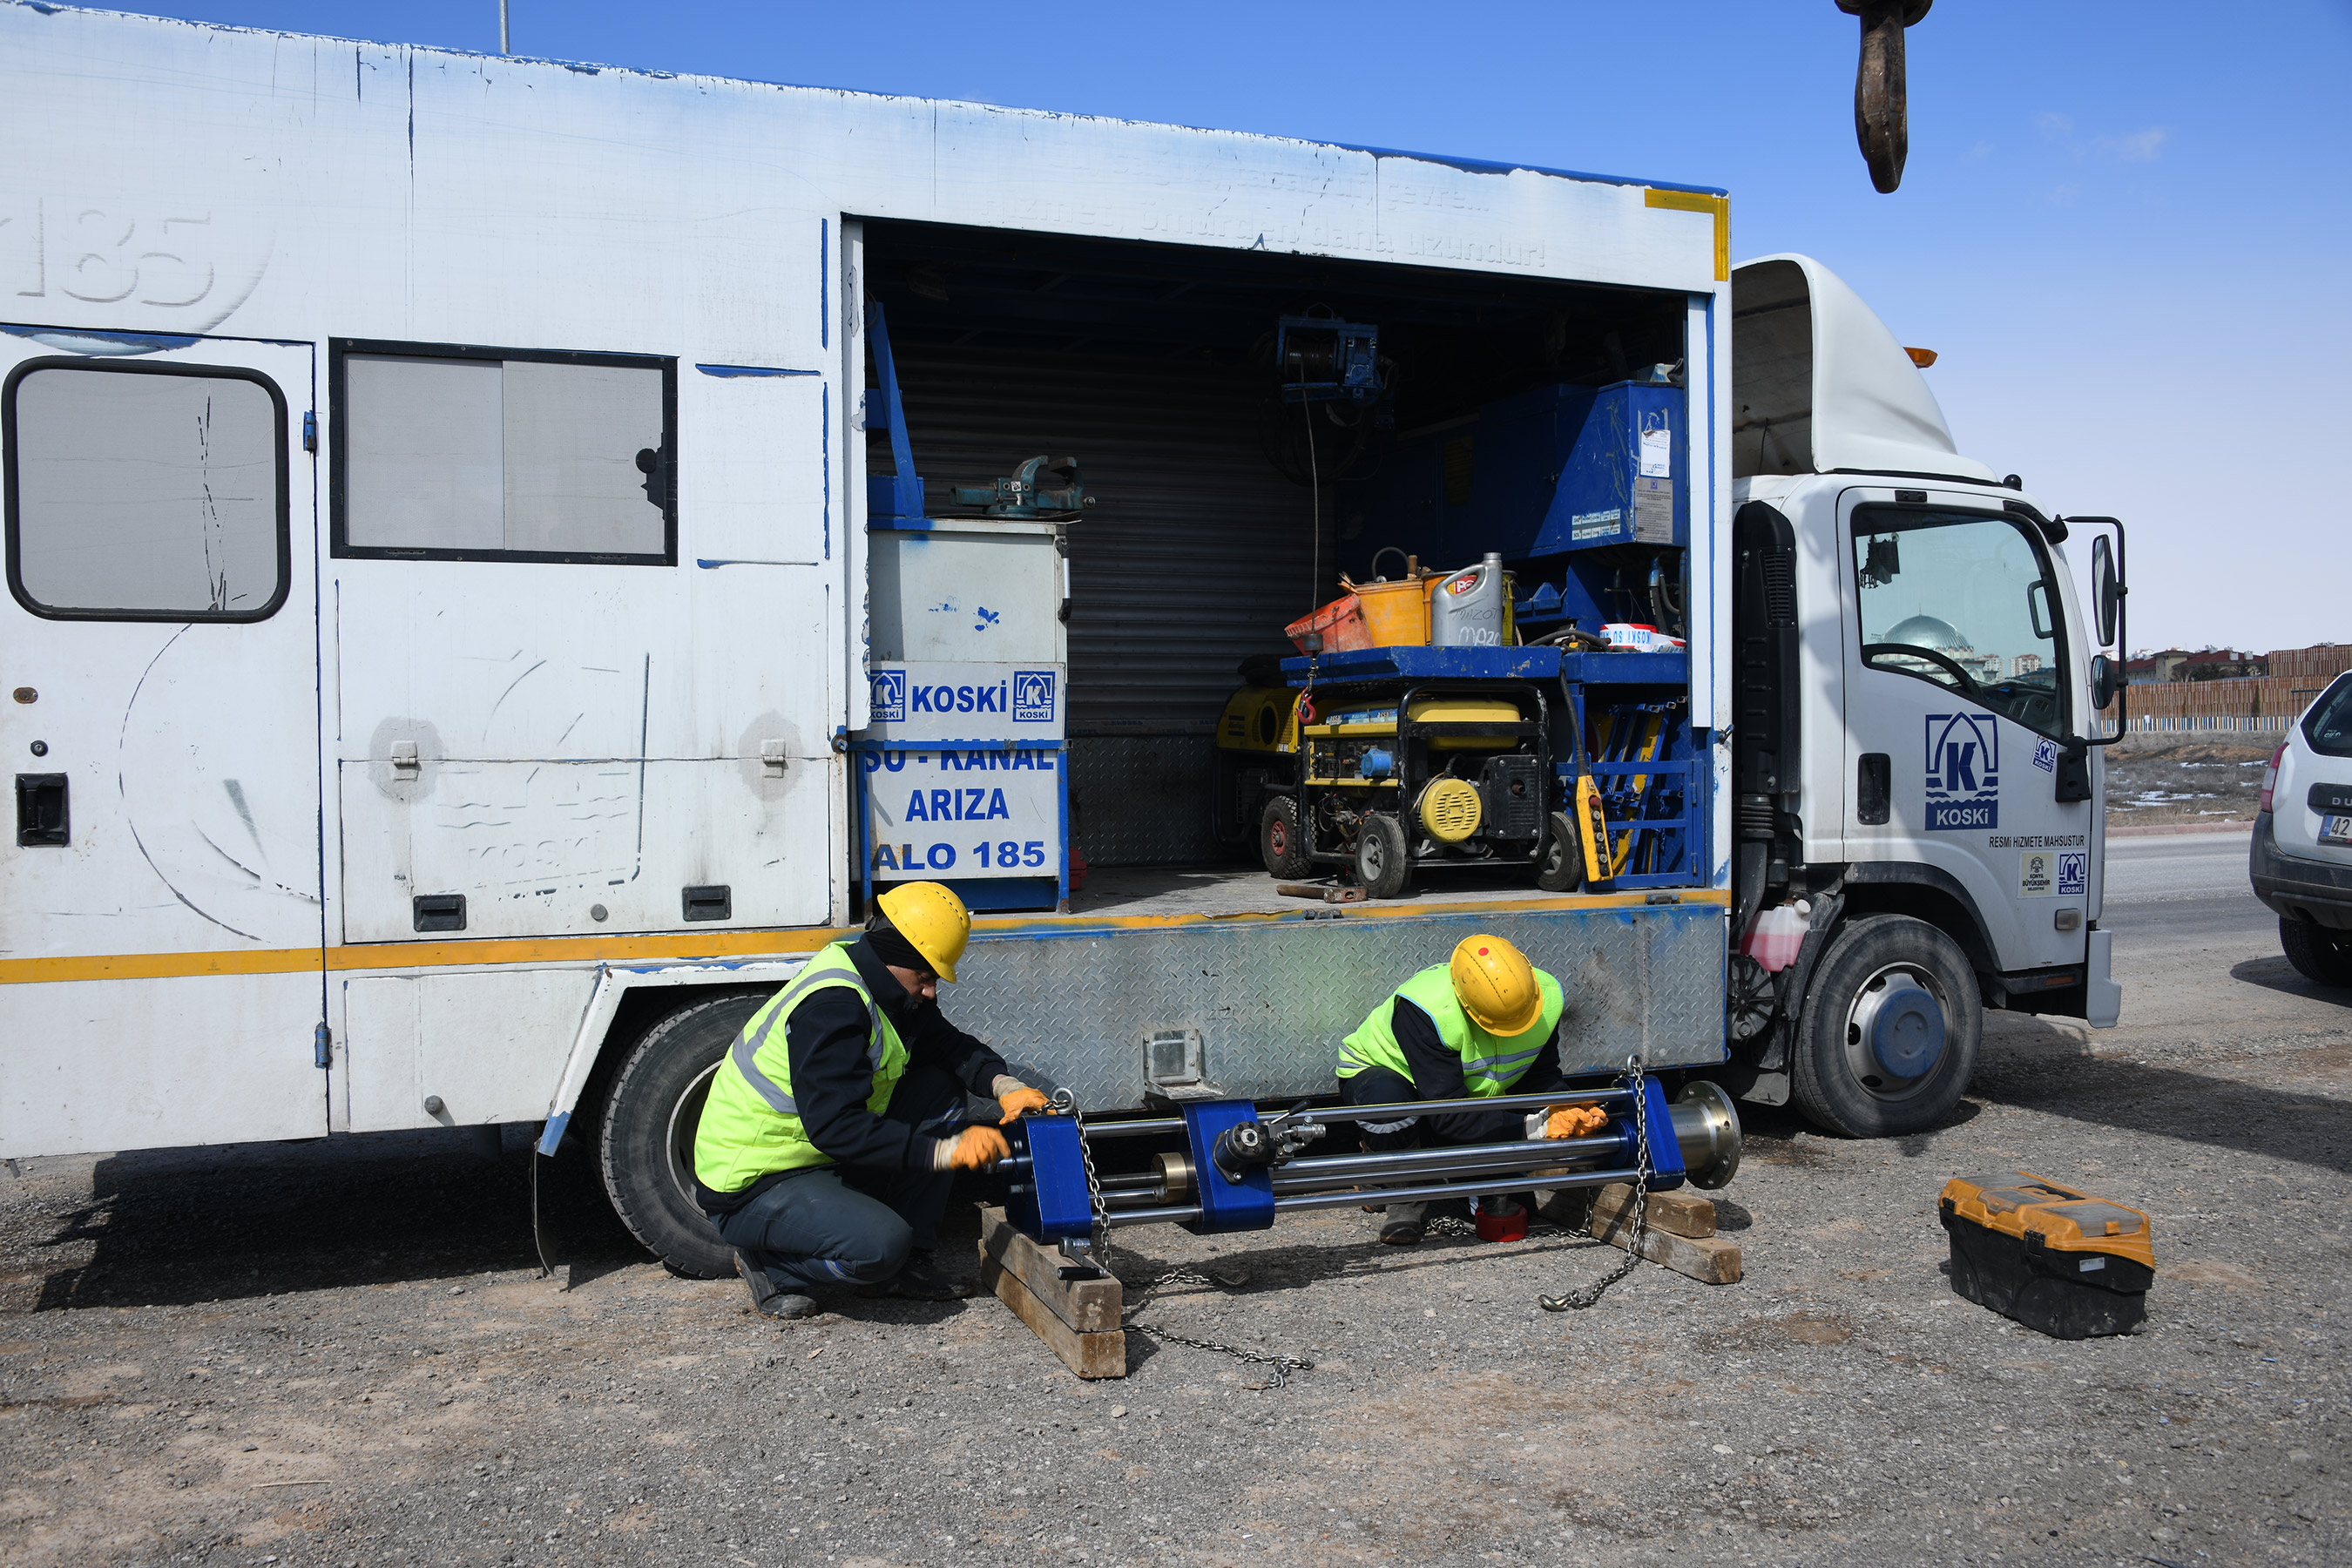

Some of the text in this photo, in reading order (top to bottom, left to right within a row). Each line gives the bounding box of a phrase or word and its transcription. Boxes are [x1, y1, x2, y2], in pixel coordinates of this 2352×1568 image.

[911, 679, 1007, 713] KOSKİ
[1019, 708, 1049, 719] KOSKİ
[865, 739, 907, 773] SU
[940, 739, 1054, 771] KANAL
[1946, 741, 1978, 792] K
[905, 787, 1010, 822] ARIZA
[2044, 835, 2085, 848] MAHSUSTUR
[2331, 817, 2350, 836] 42
[871, 841, 1046, 871] ALO 185
[2066, 862, 2078, 882] K
